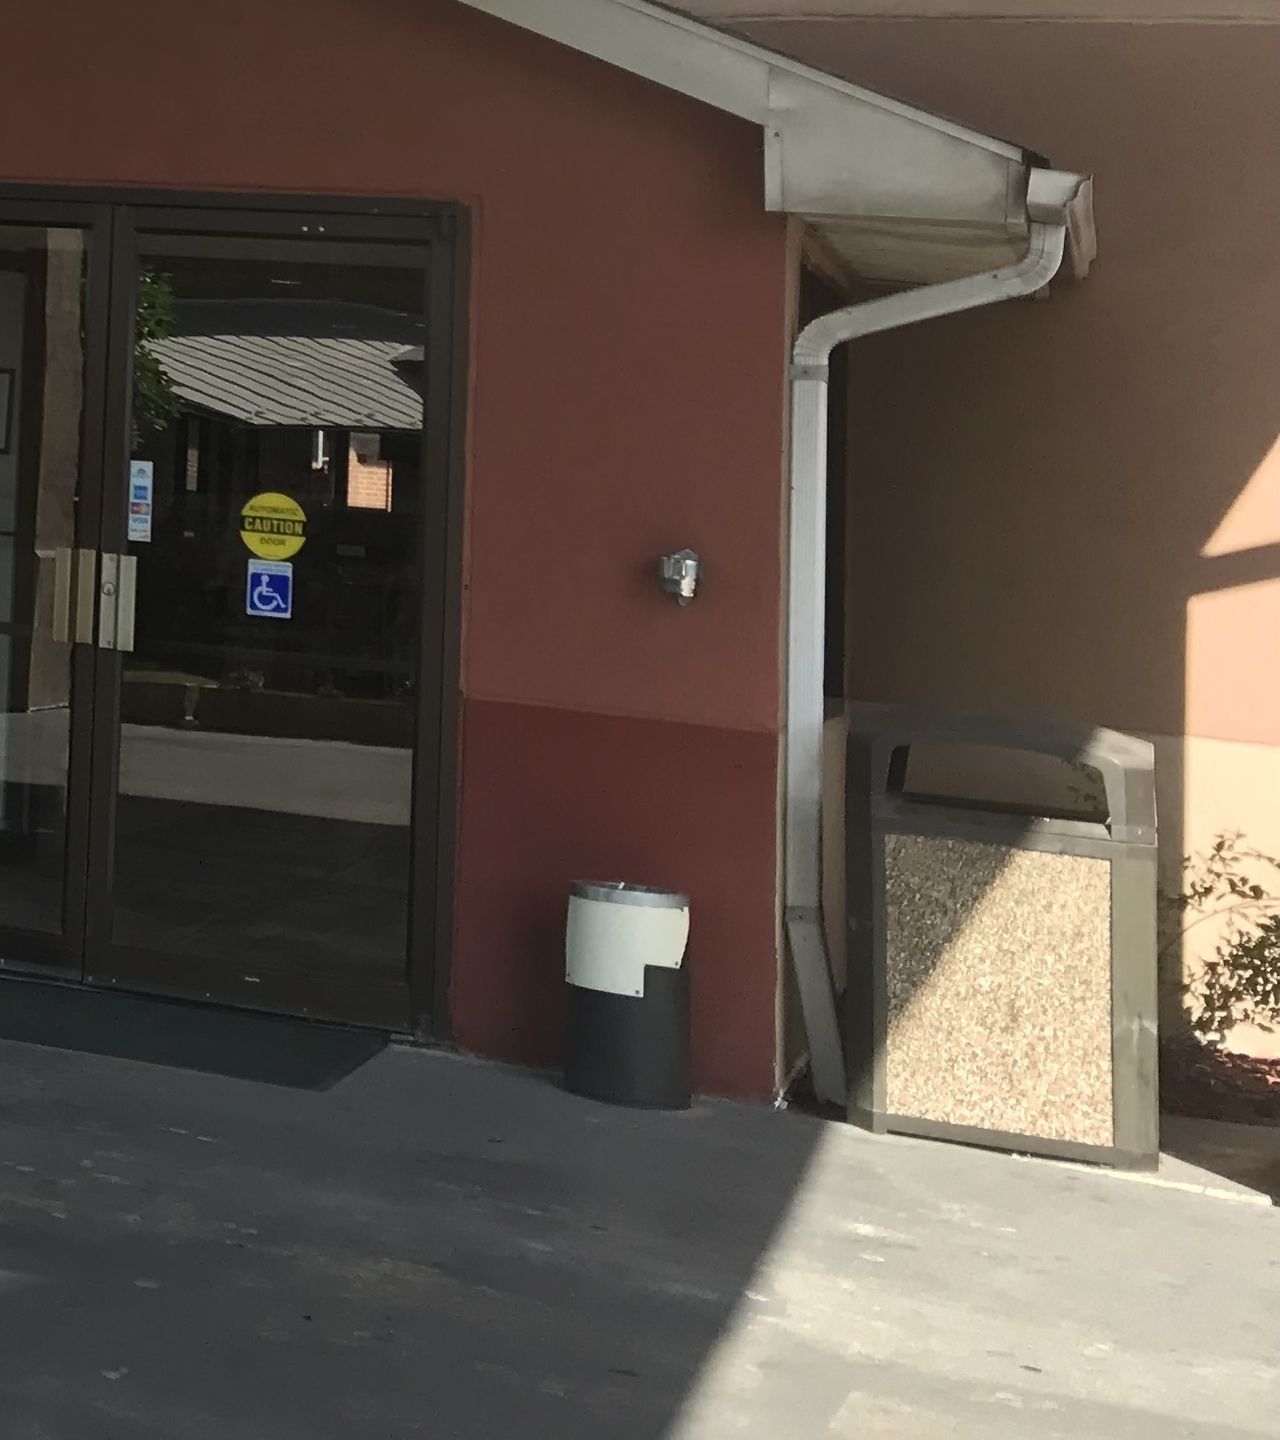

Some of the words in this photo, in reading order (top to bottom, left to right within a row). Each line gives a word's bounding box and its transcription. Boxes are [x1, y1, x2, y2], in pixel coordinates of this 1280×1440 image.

[249, 504, 300, 516] AUTOMATIC
[243, 517, 303, 535] CAUTION
[259, 536, 287, 547] DOOR
